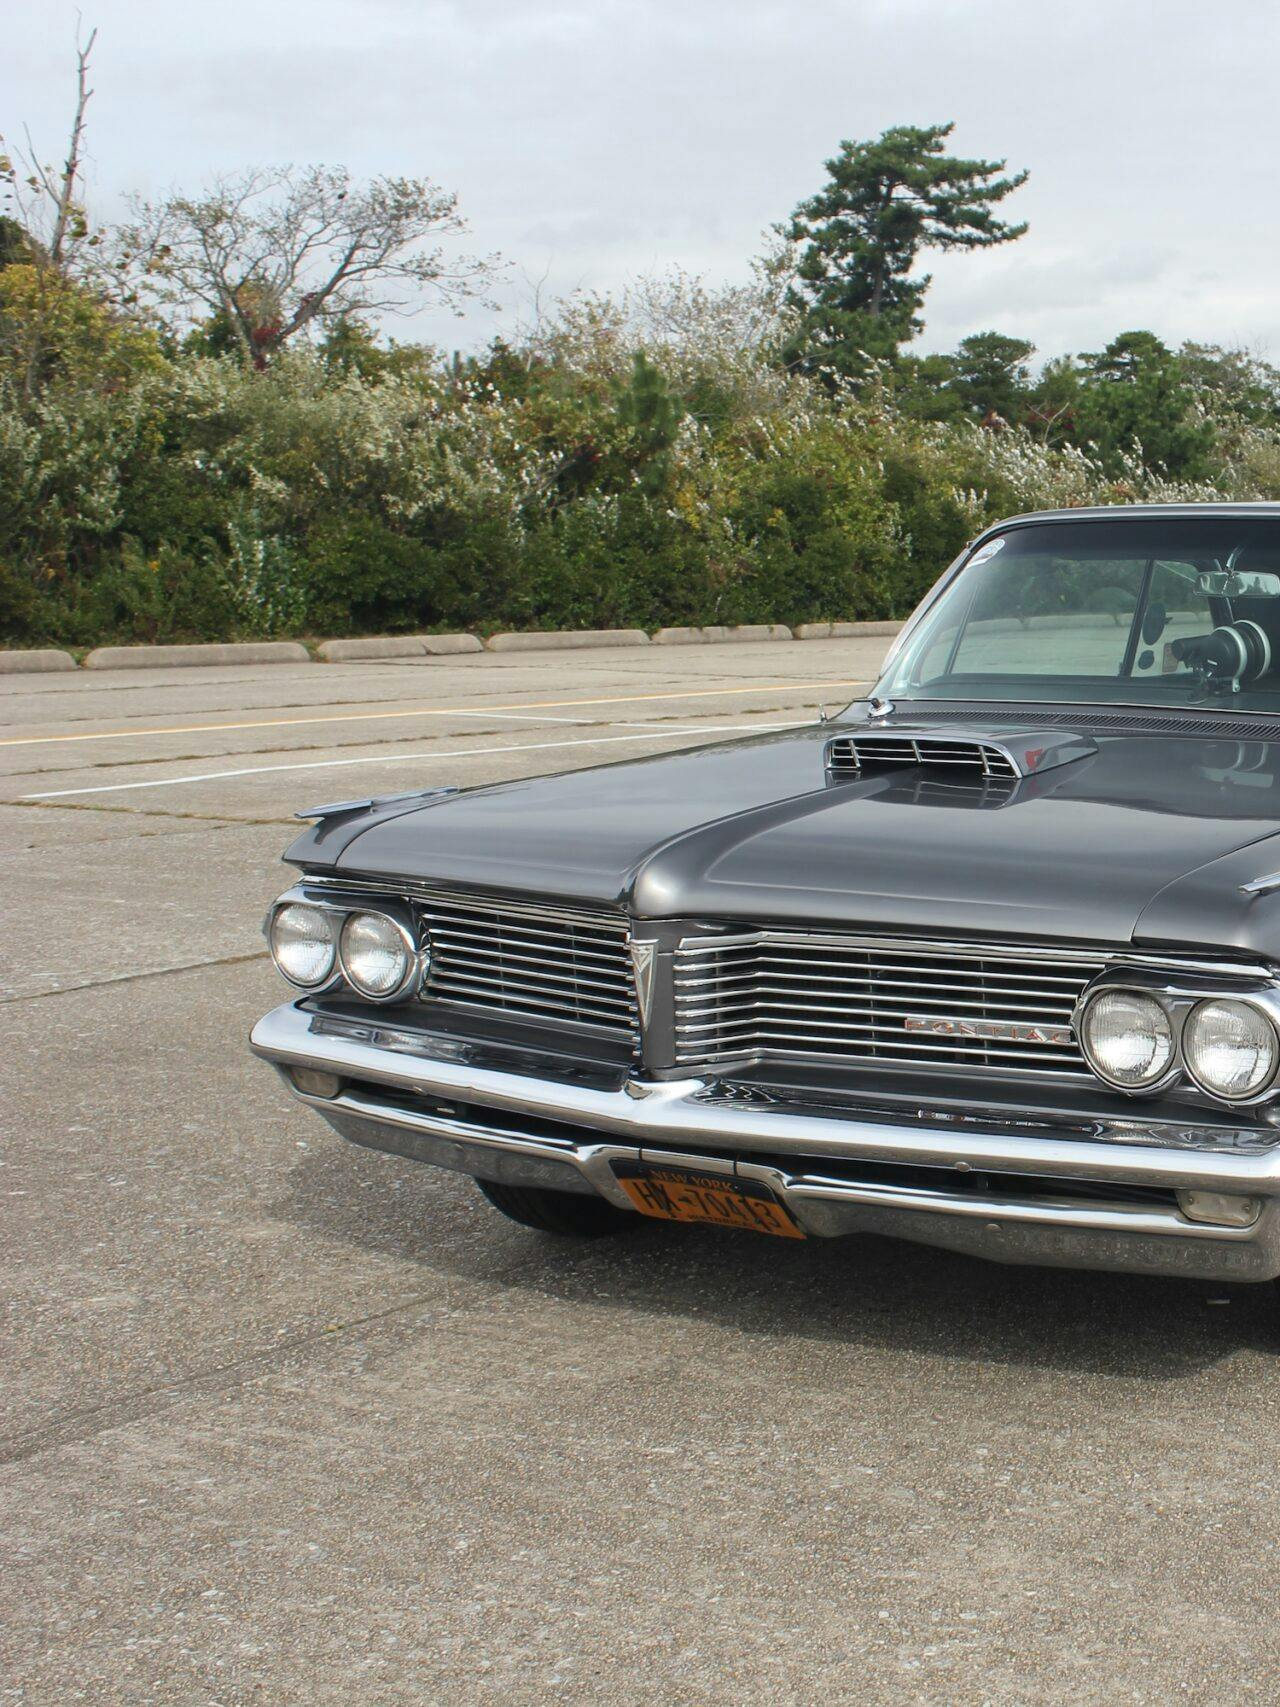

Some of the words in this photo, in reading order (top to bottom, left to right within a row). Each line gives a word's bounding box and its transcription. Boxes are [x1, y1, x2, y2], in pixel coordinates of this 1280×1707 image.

[904, 1018, 1071, 1043] PONTIAC
[650, 1169, 687, 1184] NEW
[690, 1175, 733, 1192] YORK
